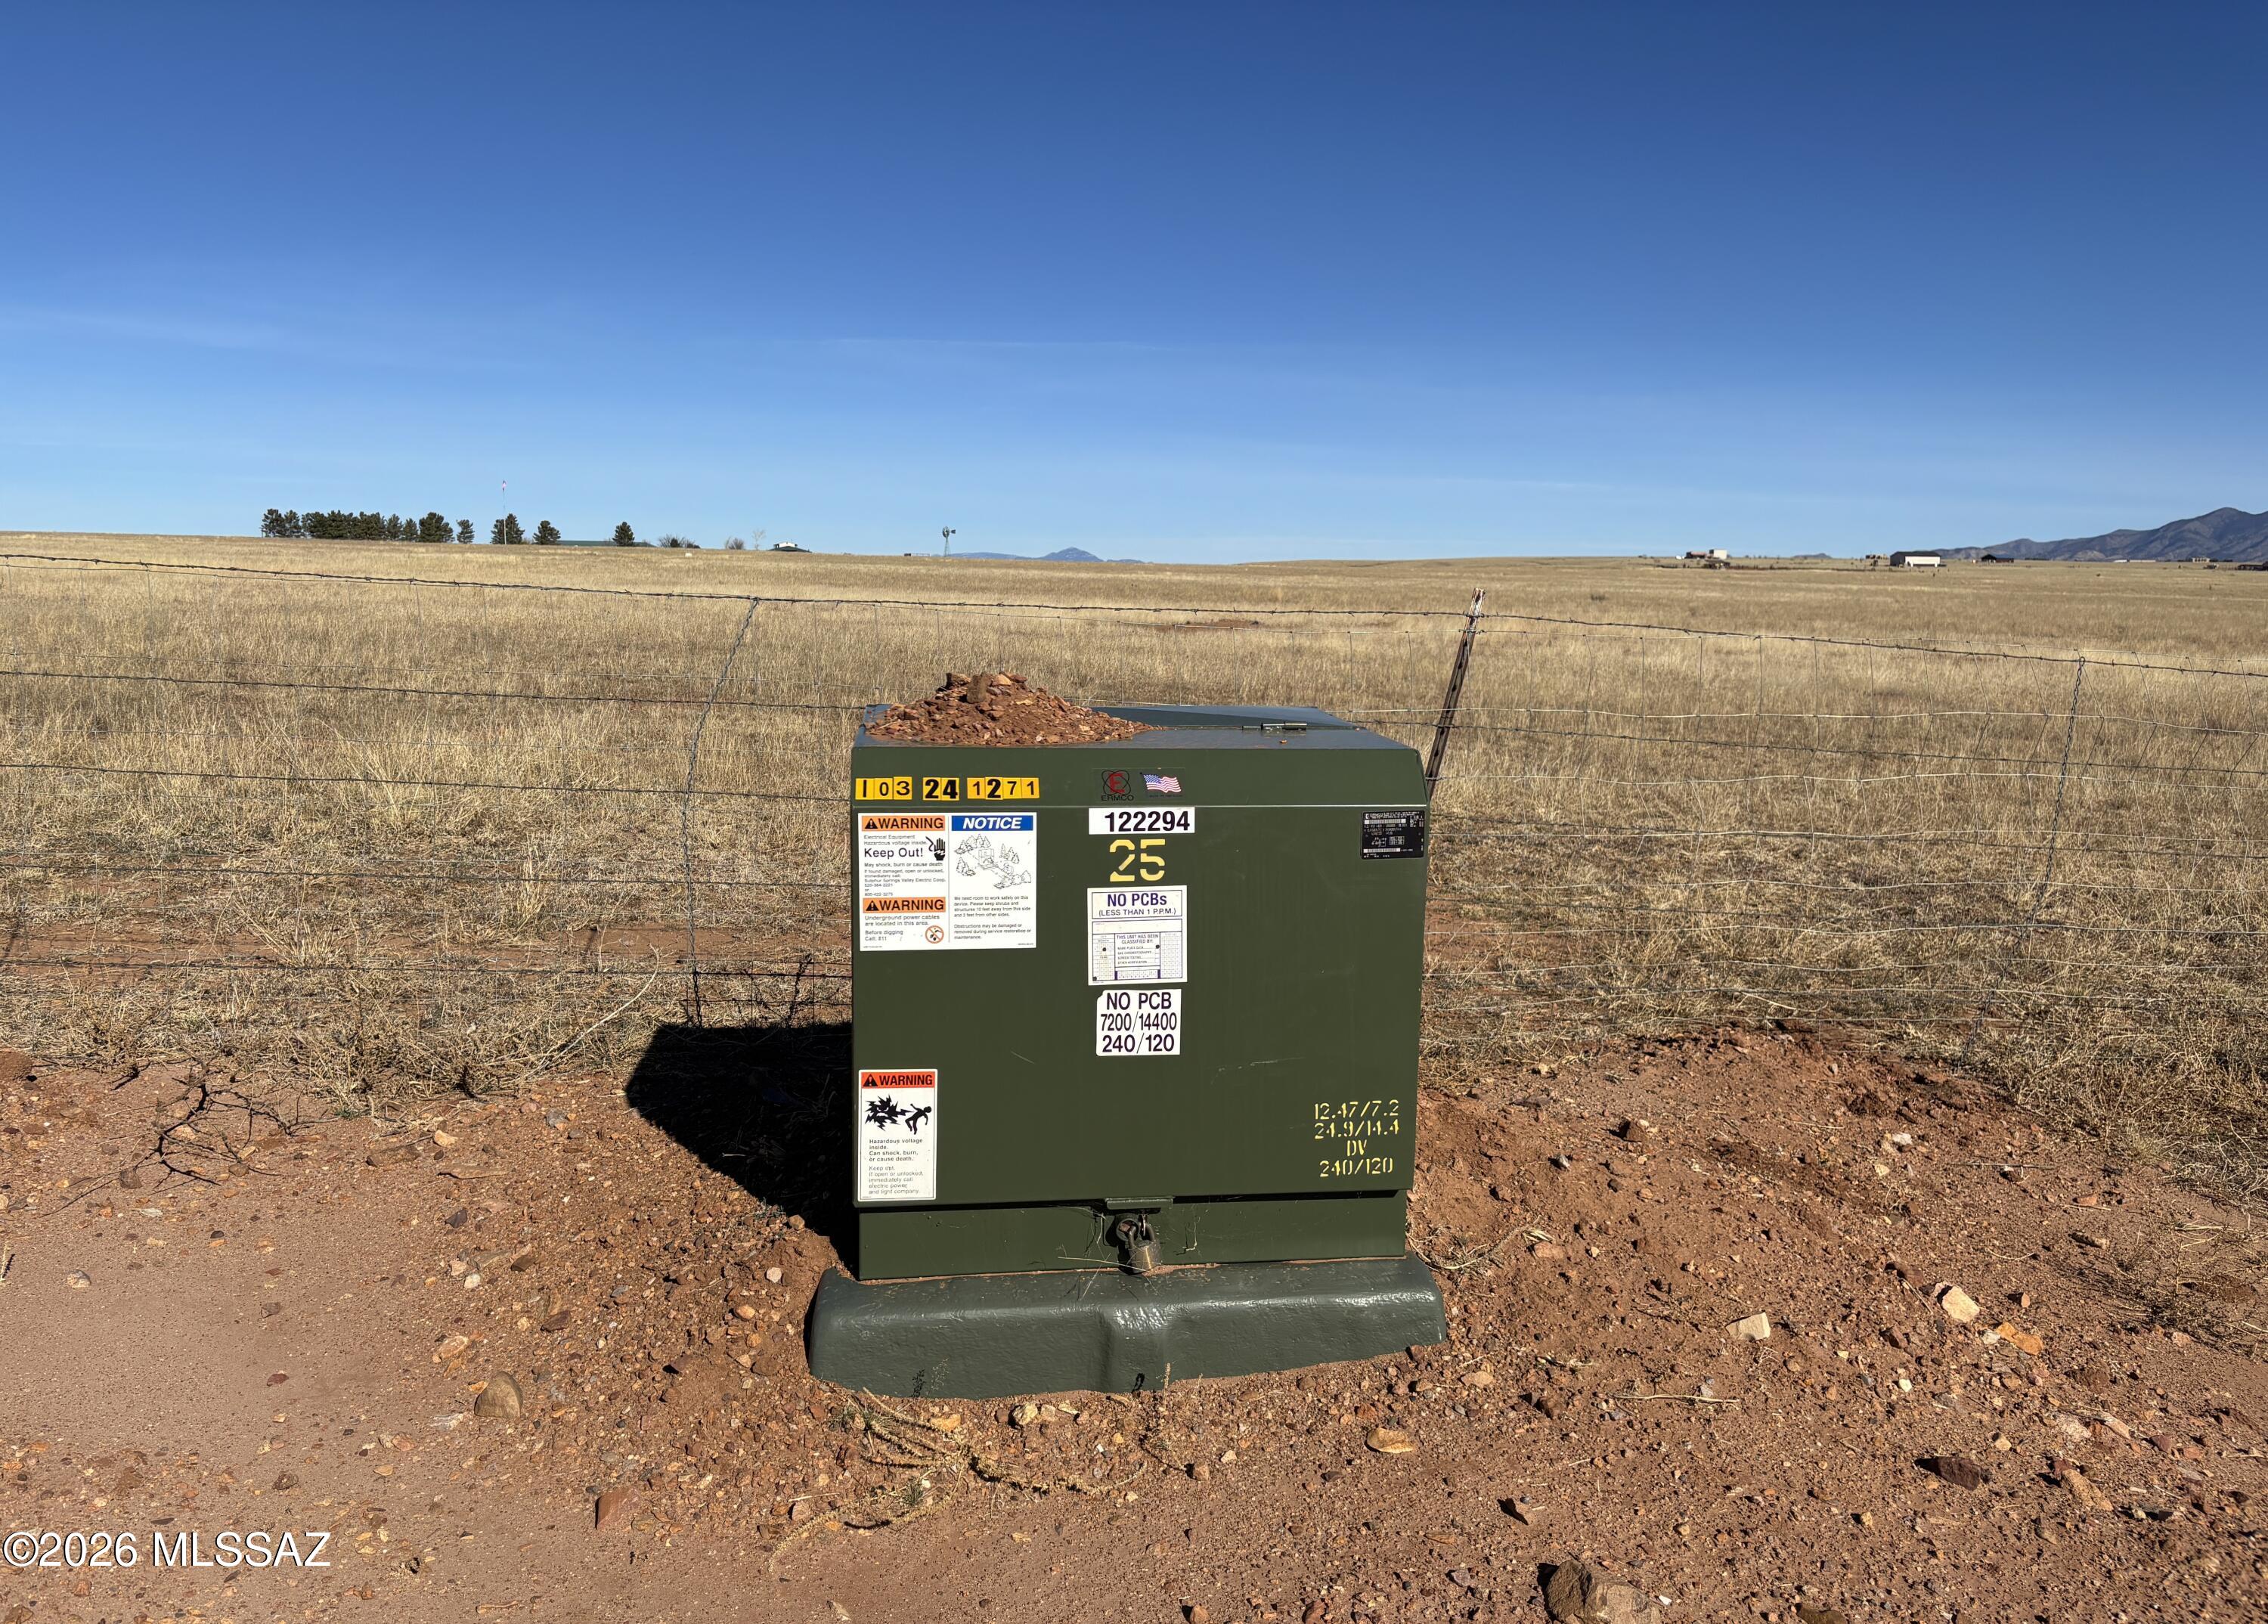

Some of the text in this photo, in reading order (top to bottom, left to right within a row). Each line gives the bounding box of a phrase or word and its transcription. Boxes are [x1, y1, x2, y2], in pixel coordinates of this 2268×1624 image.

[925, 779, 958, 799] 24
[972, 779, 1035, 798] 1271
[878, 818, 943, 829] WARNING
[962, 817, 1022, 830] NOTICE
[1105, 811, 1191, 832] 122294
[864, 848, 923, 860] Keep Out!
[1109, 839, 1166, 882] 25
[879, 899, 944, 911] WARNING
[1108, 893, 1167, 907] NO PCBs
[1107, 992, 1172, 1010] NO PCB
[1100, 1011, 1178, 1033] 7200/14400
[1101, 1033, 1175, 1054] 240/120
[879, 1074, 933, 1086] WARNING
[1315, 1099, 1399, 1120] 12.47/7.2
[1315, 1119, 1399, 1139] 24.9/14.4
[1346, 1139, 1367, 1157] DV
[1319, 1158, 1393, 1177] 240/120
